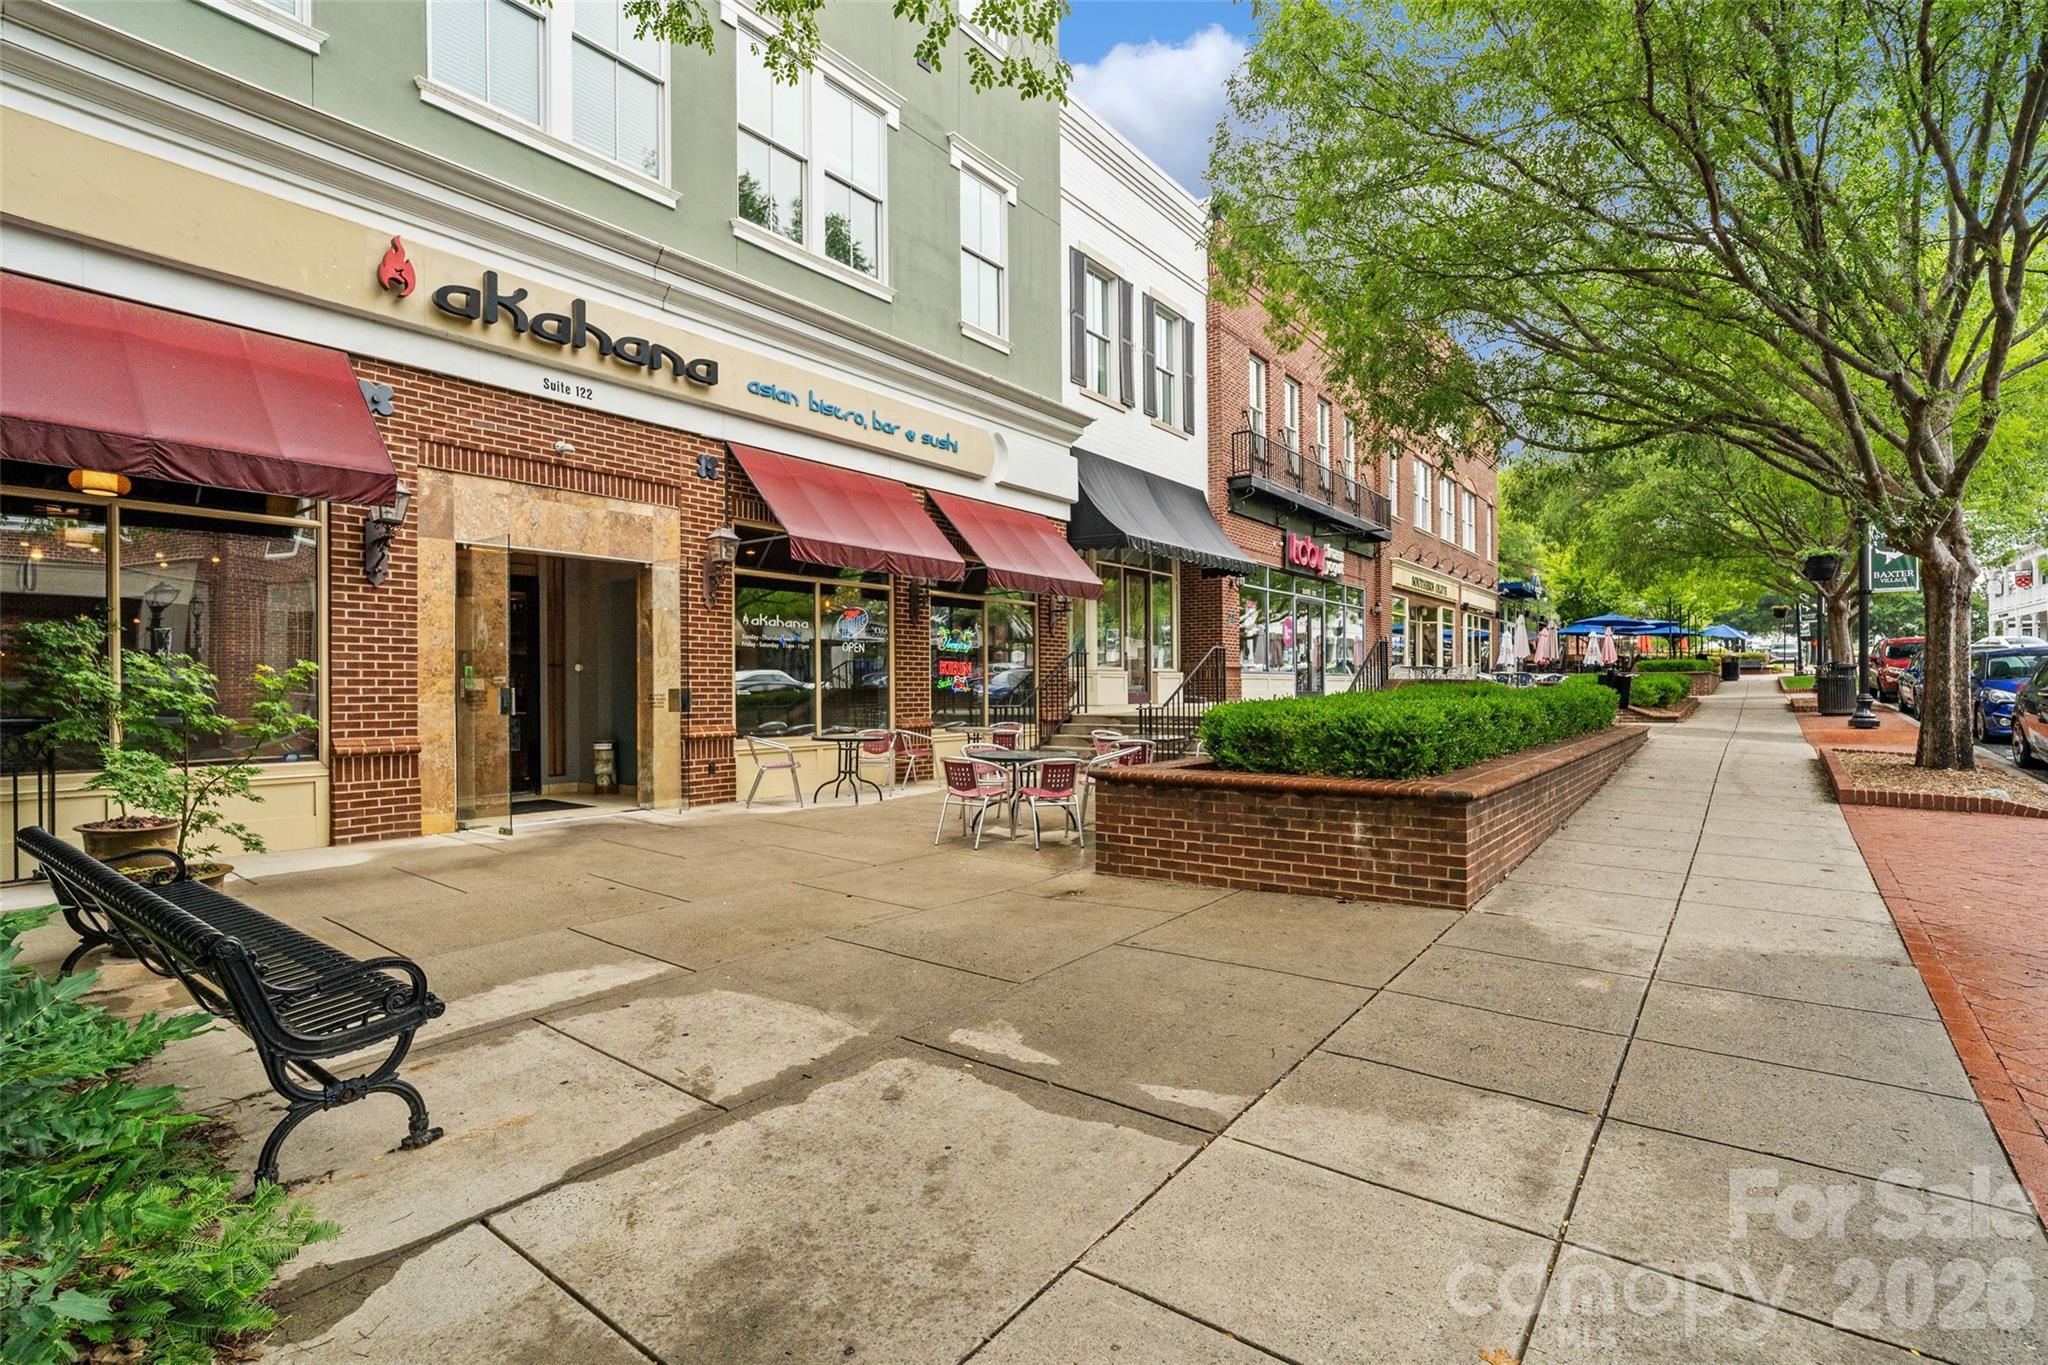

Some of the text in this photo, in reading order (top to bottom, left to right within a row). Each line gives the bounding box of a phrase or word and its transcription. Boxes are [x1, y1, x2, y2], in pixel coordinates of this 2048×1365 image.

[543, 377, 593, 401] Suite 122
[747, 380, 799, 407] asian
[808, 390, 867, 430] bistro,
[872, 410, 901, 436] bar
[921, 433, 958, 454] sushi
[1873, 569, 1914, 579] BAXTER
[841, 641, 865, 653] OPEN
[939, 660, 972, 677] KIRIN
